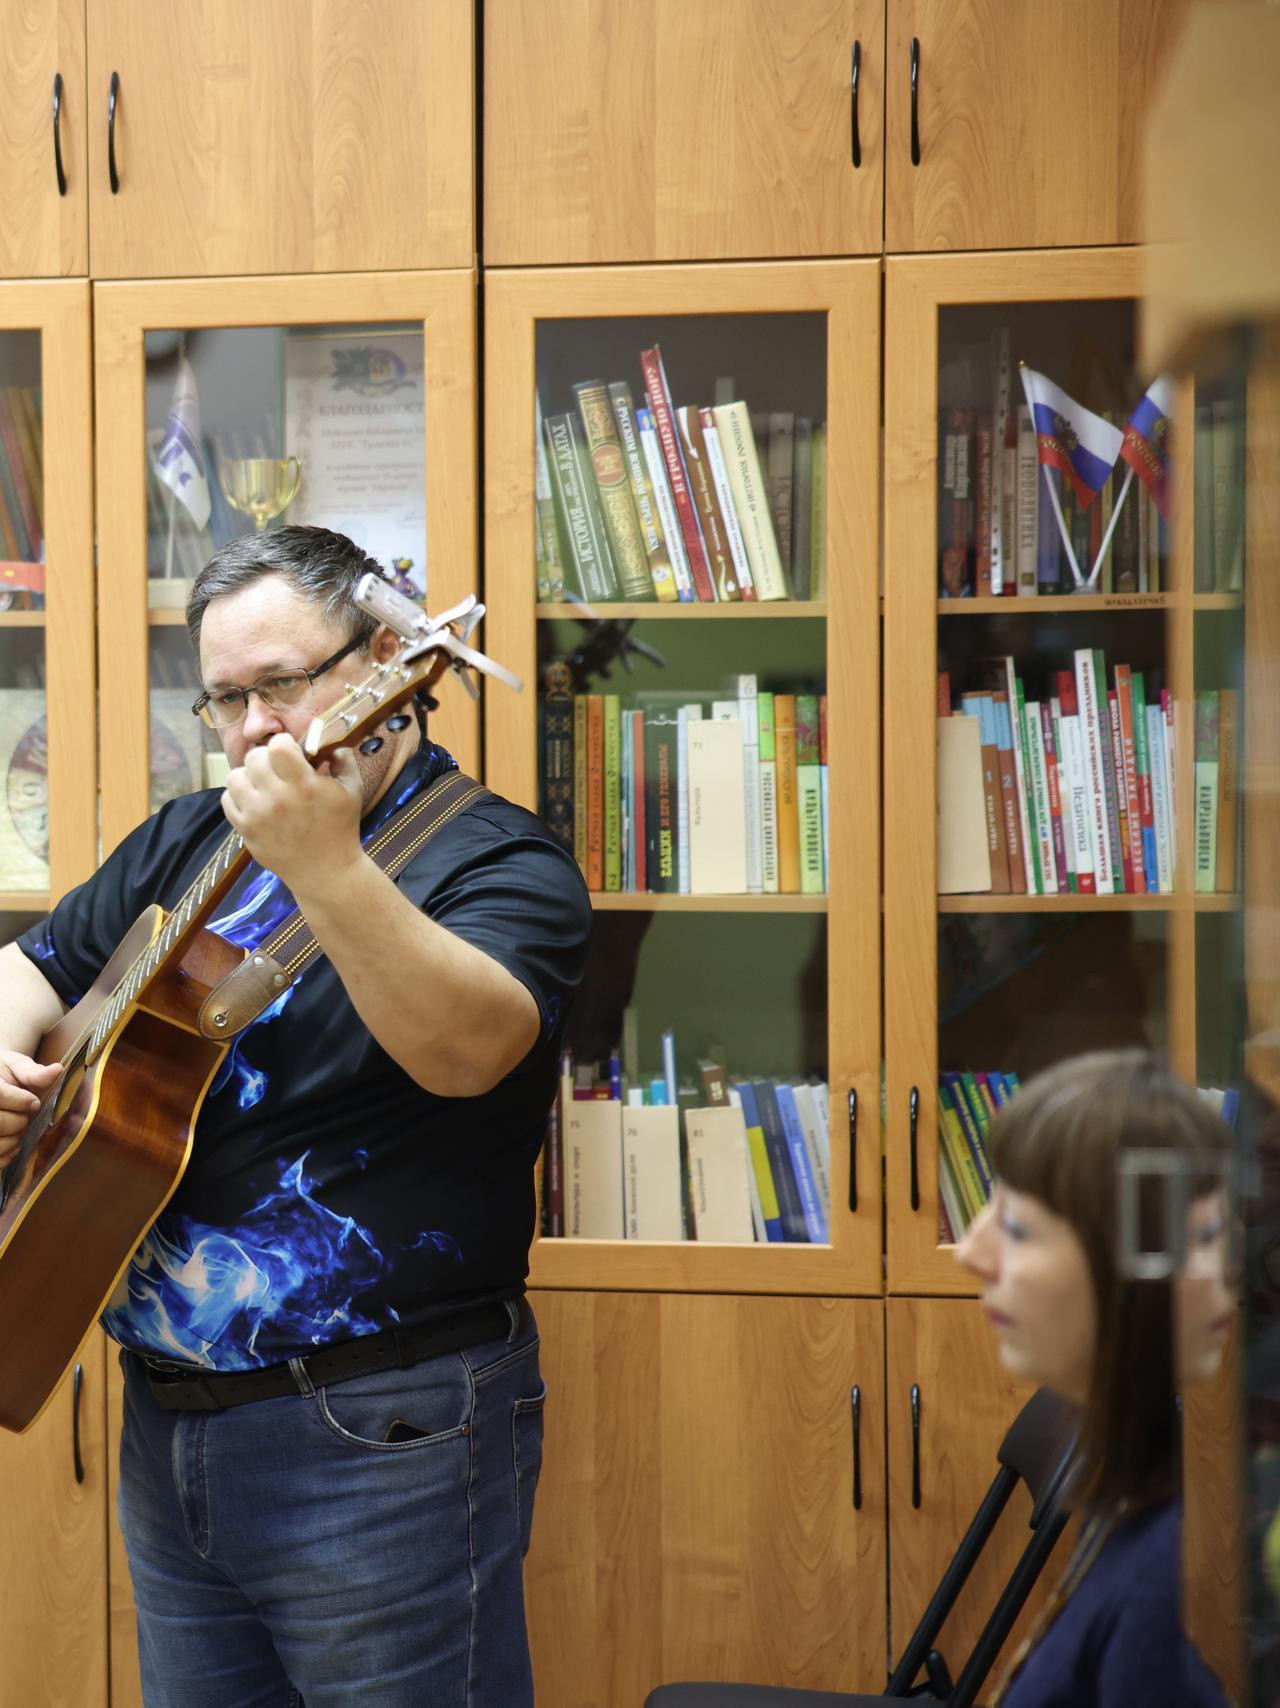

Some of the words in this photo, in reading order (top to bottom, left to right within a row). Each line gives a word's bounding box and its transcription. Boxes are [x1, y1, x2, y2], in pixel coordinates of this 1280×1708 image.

[647, 366, 664, 403] ПОРУ
[552, 424, 571, 460] ДАТАХ
[619, 404, 636, 450] РУССКИМ
[628, 452, 649, 494] ВОИНОМ
[657, 407, 680, 481] ГРОЗНУЮ
[739, 461, 755, 503] ИСТОРИЯ
[1021, 456, 1036, 549] ГЕОПОЛИТИКА
[570, 507, 594, 562] ИСТОРИЯ
[1082, 662, 1096, 728] праздников
[1110, 699, 1119, 730] ШКОЛА
[658, 744, 669, 795] ГЕНЕРАЛЫ
[1088, 731, 1101, 794] российских
[1113, 732, 1122, 766] РАННЕГО
[1125, 737, 1137, 800] ЗАГАДКИ
[764, 772, 775, 822] РОССИЙСКАЯ
[1094, 798, 1106, 831] книга
[1116, 768, 1126, 810] РАЗВИТИЯ
[806, 789, 819, 872] КУЛЬТУРОЛОГИЯ
[987, 795, 998, 850] ПЕДАГОГИКА
[1005, 800, 1018, 855] ПЕДАГОГИКА
[1071, 786, 1086, 851] Педагогика
[764, 826, 775, 881] ЦИВИЛИЗАЦИЯ
[1096, 833, 1109, 882] Большая
